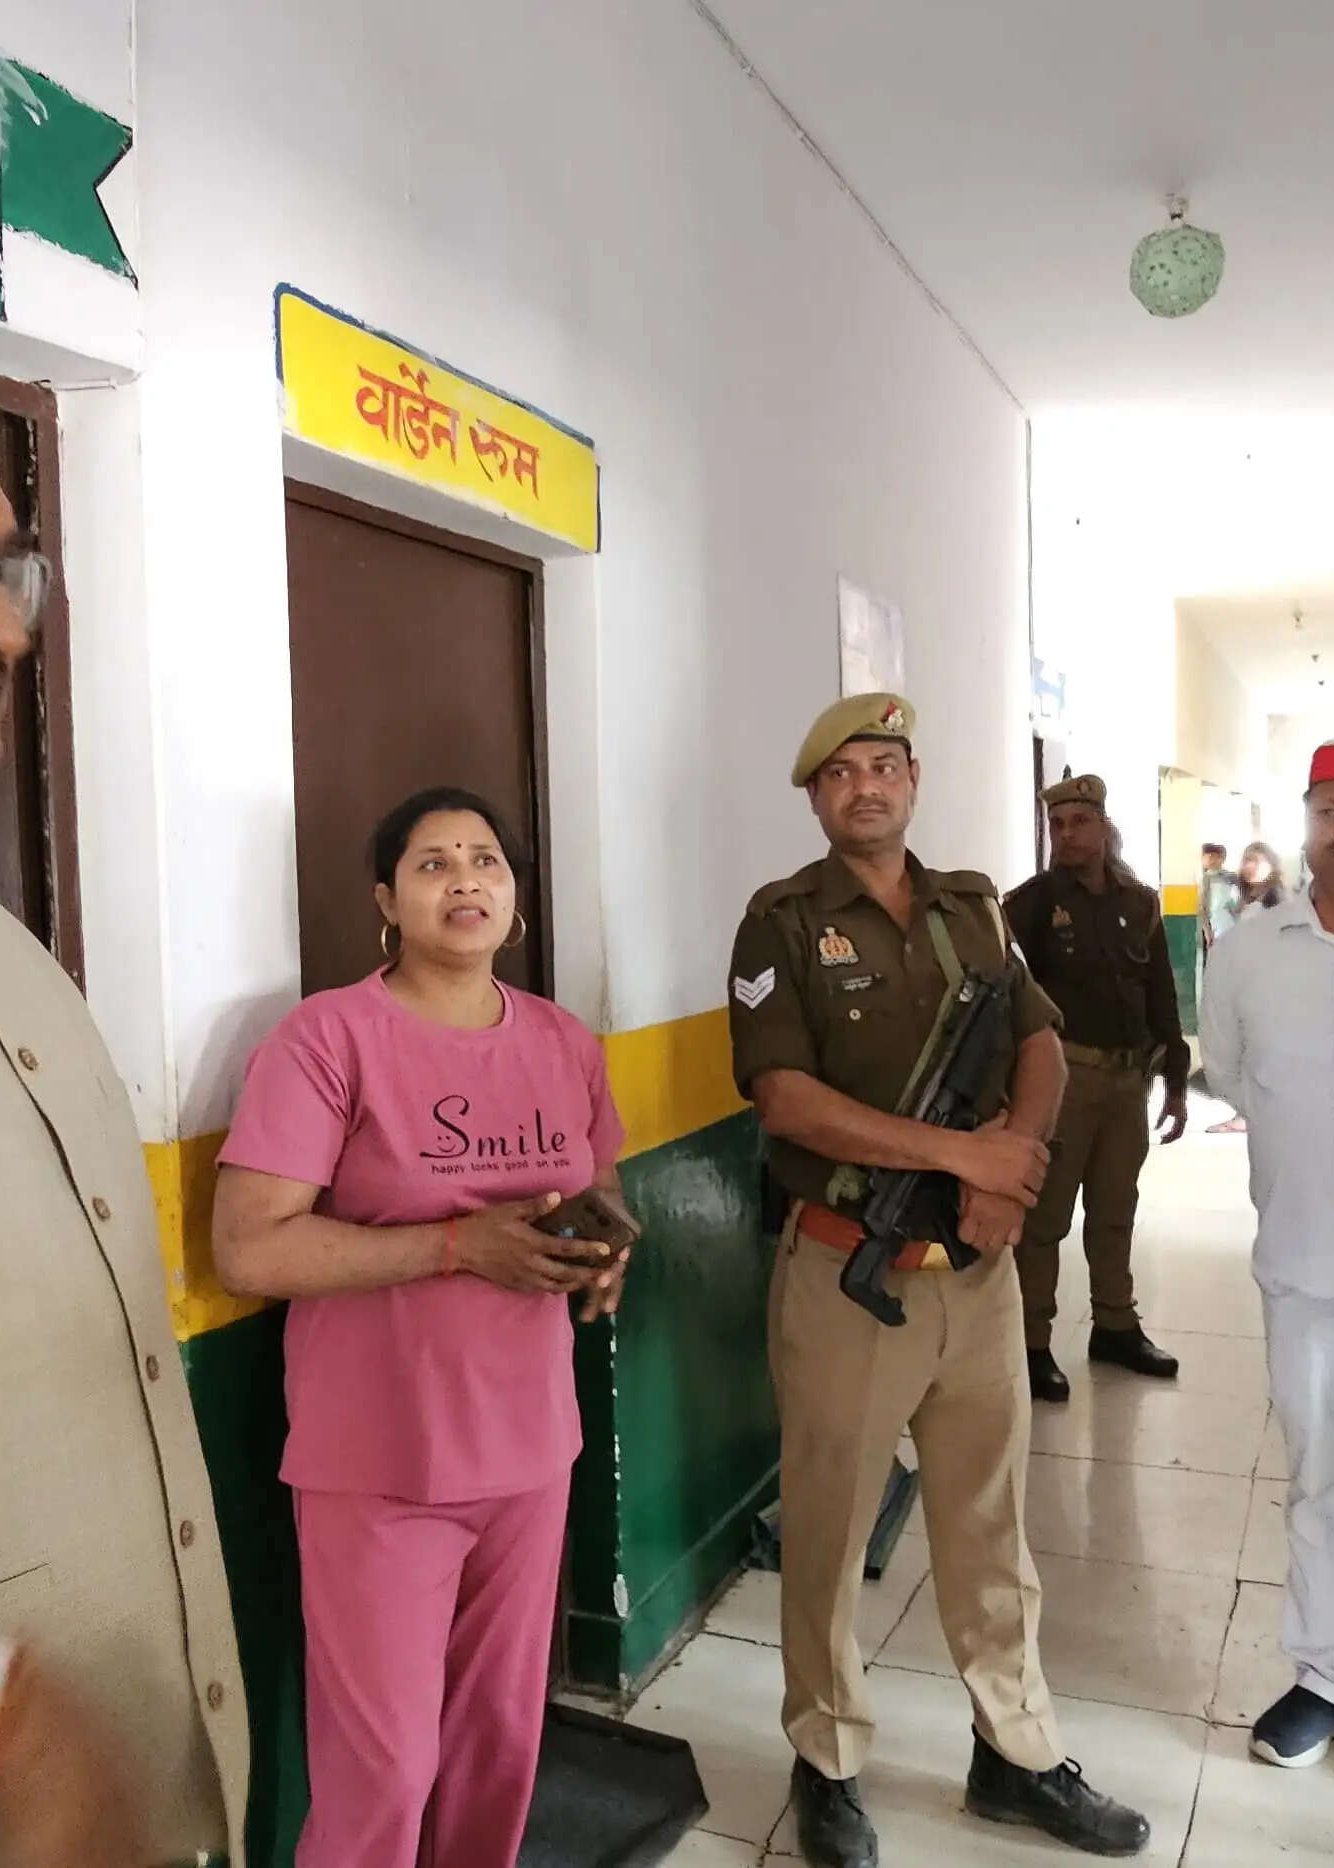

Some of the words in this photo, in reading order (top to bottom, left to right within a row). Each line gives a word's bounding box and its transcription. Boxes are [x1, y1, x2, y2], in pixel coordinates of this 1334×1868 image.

[469, 416, 540, 501] रूम
[419, 1095, 565, 1158] Smile
[431, 1163, 465, 1175] happy
